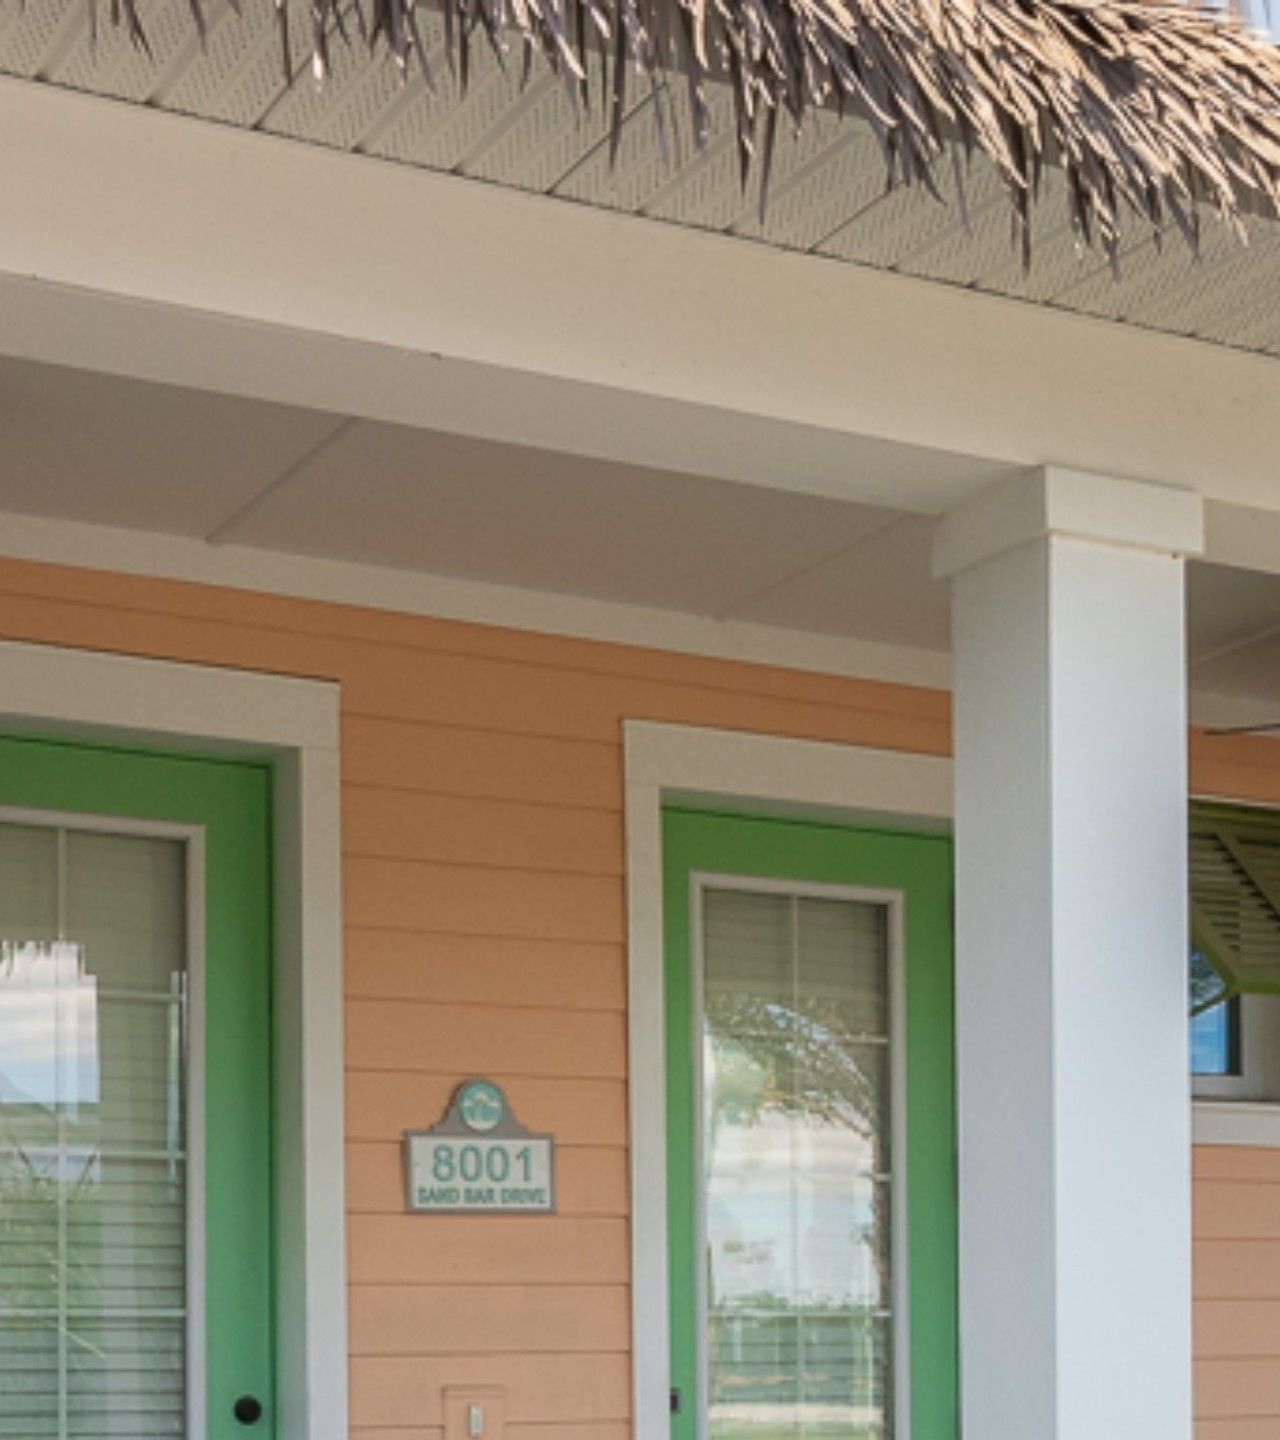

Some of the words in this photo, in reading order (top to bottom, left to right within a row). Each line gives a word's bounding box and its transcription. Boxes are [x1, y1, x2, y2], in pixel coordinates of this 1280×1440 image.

[431, 1144, 532, 1183] 8001
[417, 1186, 460, 1205] SAND
[463, 1187, 496, 1205] BAR
[500, 1187, 547, 1205] DRIVE
